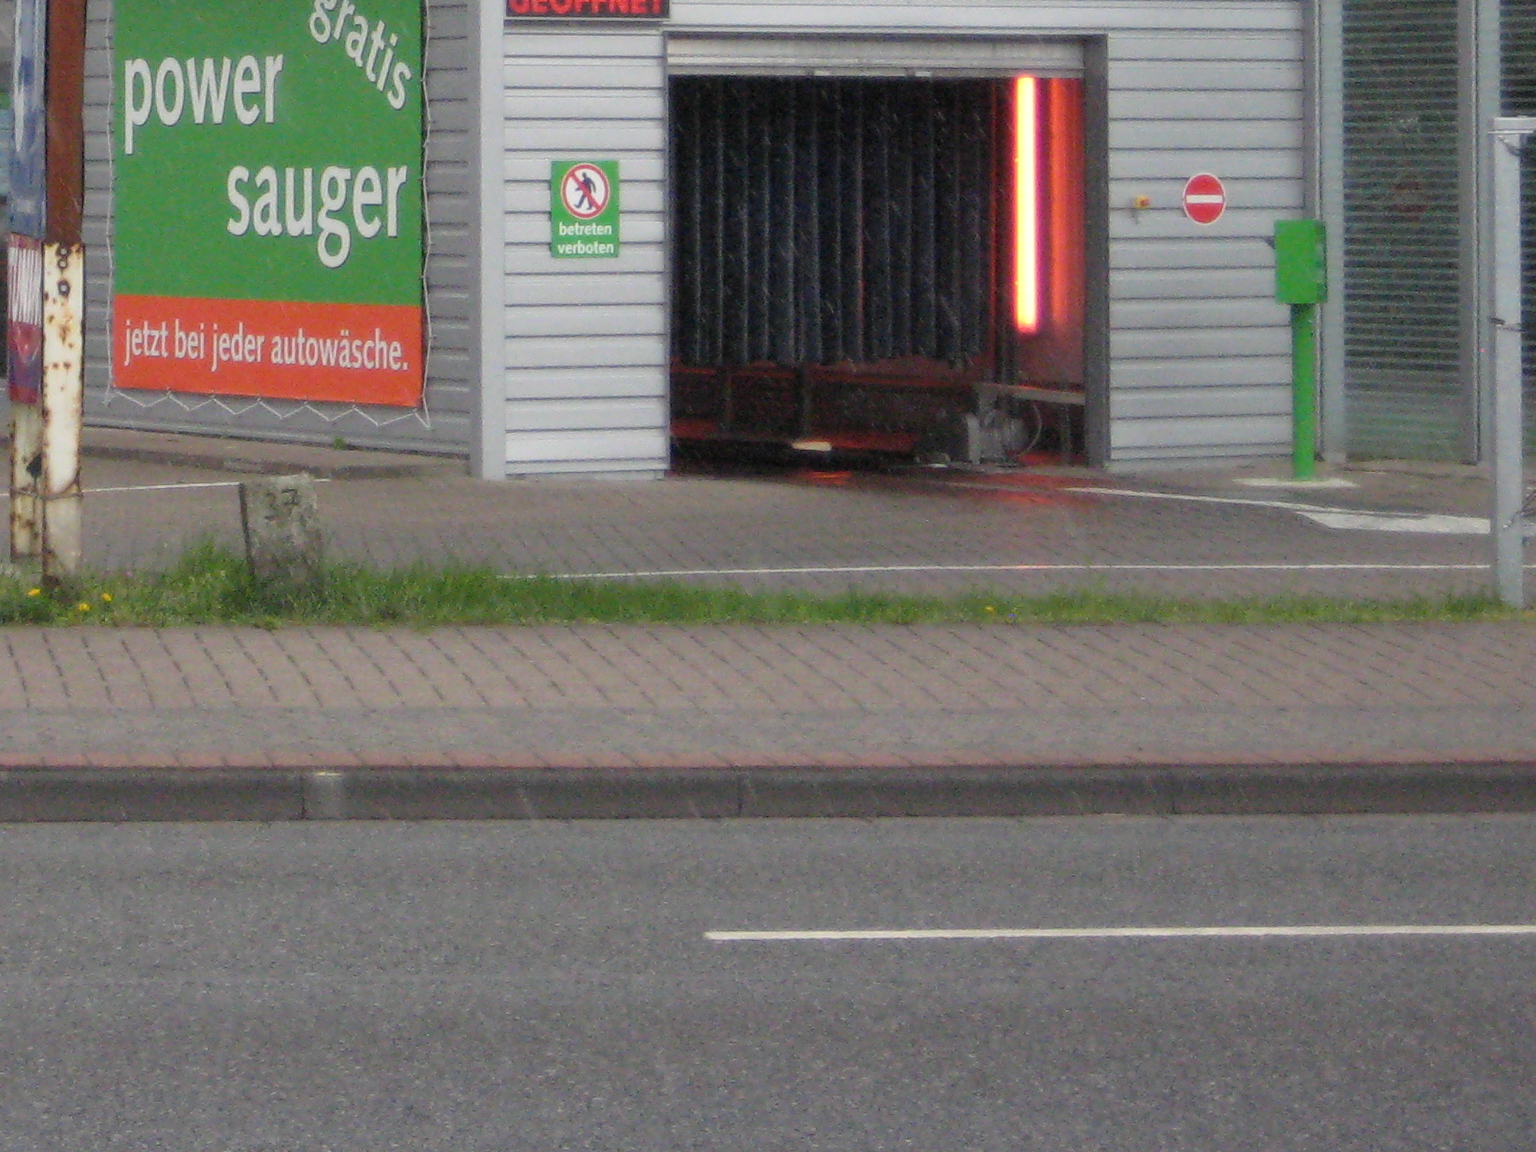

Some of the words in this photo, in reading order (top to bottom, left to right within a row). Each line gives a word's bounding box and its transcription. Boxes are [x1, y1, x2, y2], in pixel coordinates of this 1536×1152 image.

[124, 54, 284, 155] power
[226, 165, 408, 268] sauger
[558, 221, 613, 236] betreten
[557, 239, 615, 254] verboten
[124, 319, 168, 366] jetzt
[174, 318, 205, 359] bei
[211, 322, 265, 372] jeder
[271, 328, 409, 370] autowäsche.
